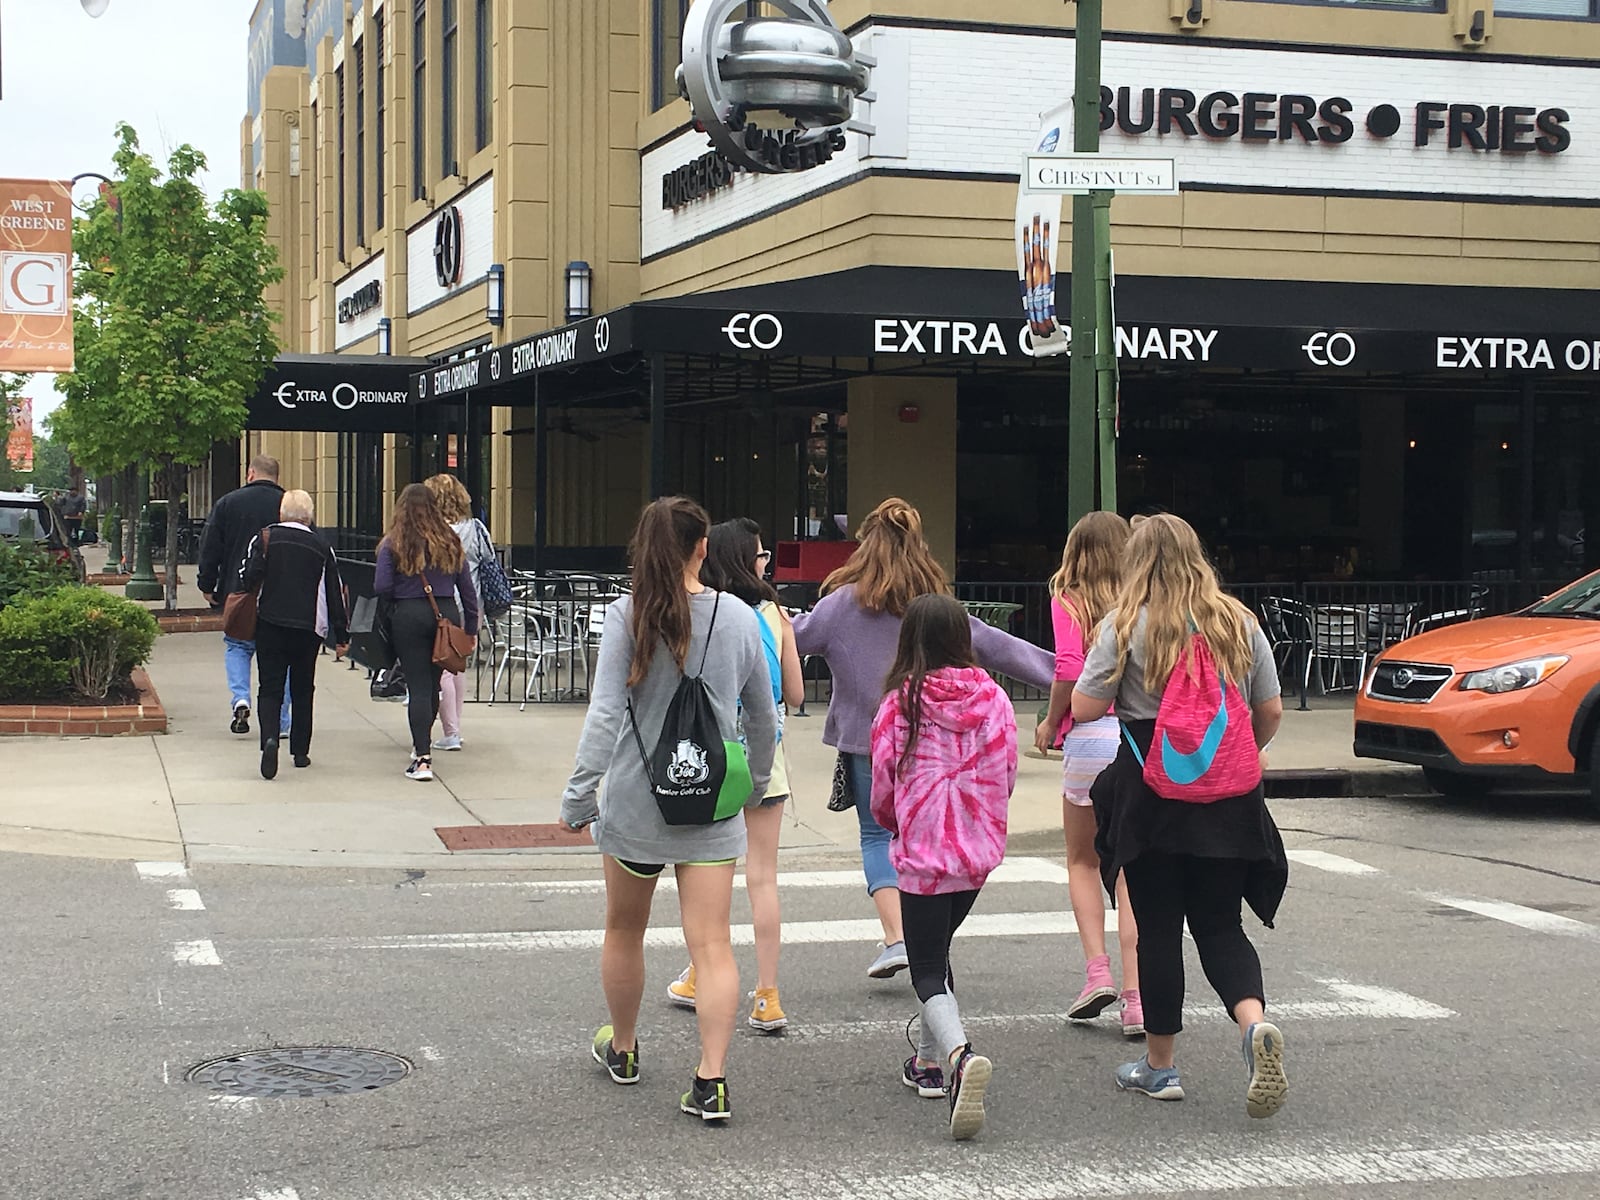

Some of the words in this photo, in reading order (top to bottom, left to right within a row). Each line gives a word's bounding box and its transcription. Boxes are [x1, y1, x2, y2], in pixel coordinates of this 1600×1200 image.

[1415, 101, 1571, 153] FRIES
[1038, 168, 1144, 186] CHESTNUT
[0, 217, 66, 231] GREENE
[11, 200, 55, 214] WEST
[10, 260, 56, 306] G
[512, 344, 535, 375] EXTRA
[536, 329, 578, 368] ORDINARY
[874, 319, 1007, 356] EXTRA
[1018, 325, 1219, 362] ONARY
[1436, 337, 1556, 370] EXTRA
[1565, 340, 1600, 371] O
[434, 370, 451, 396] EXTRA
[451, 360, 480, 391] ORDINARY
[272, 381, 327, 408] EXTRA
[332, 383, 409, 410] ORDINARY
[680, 787, 695, 796] Golf
[695, 787, 711, 796] Club
